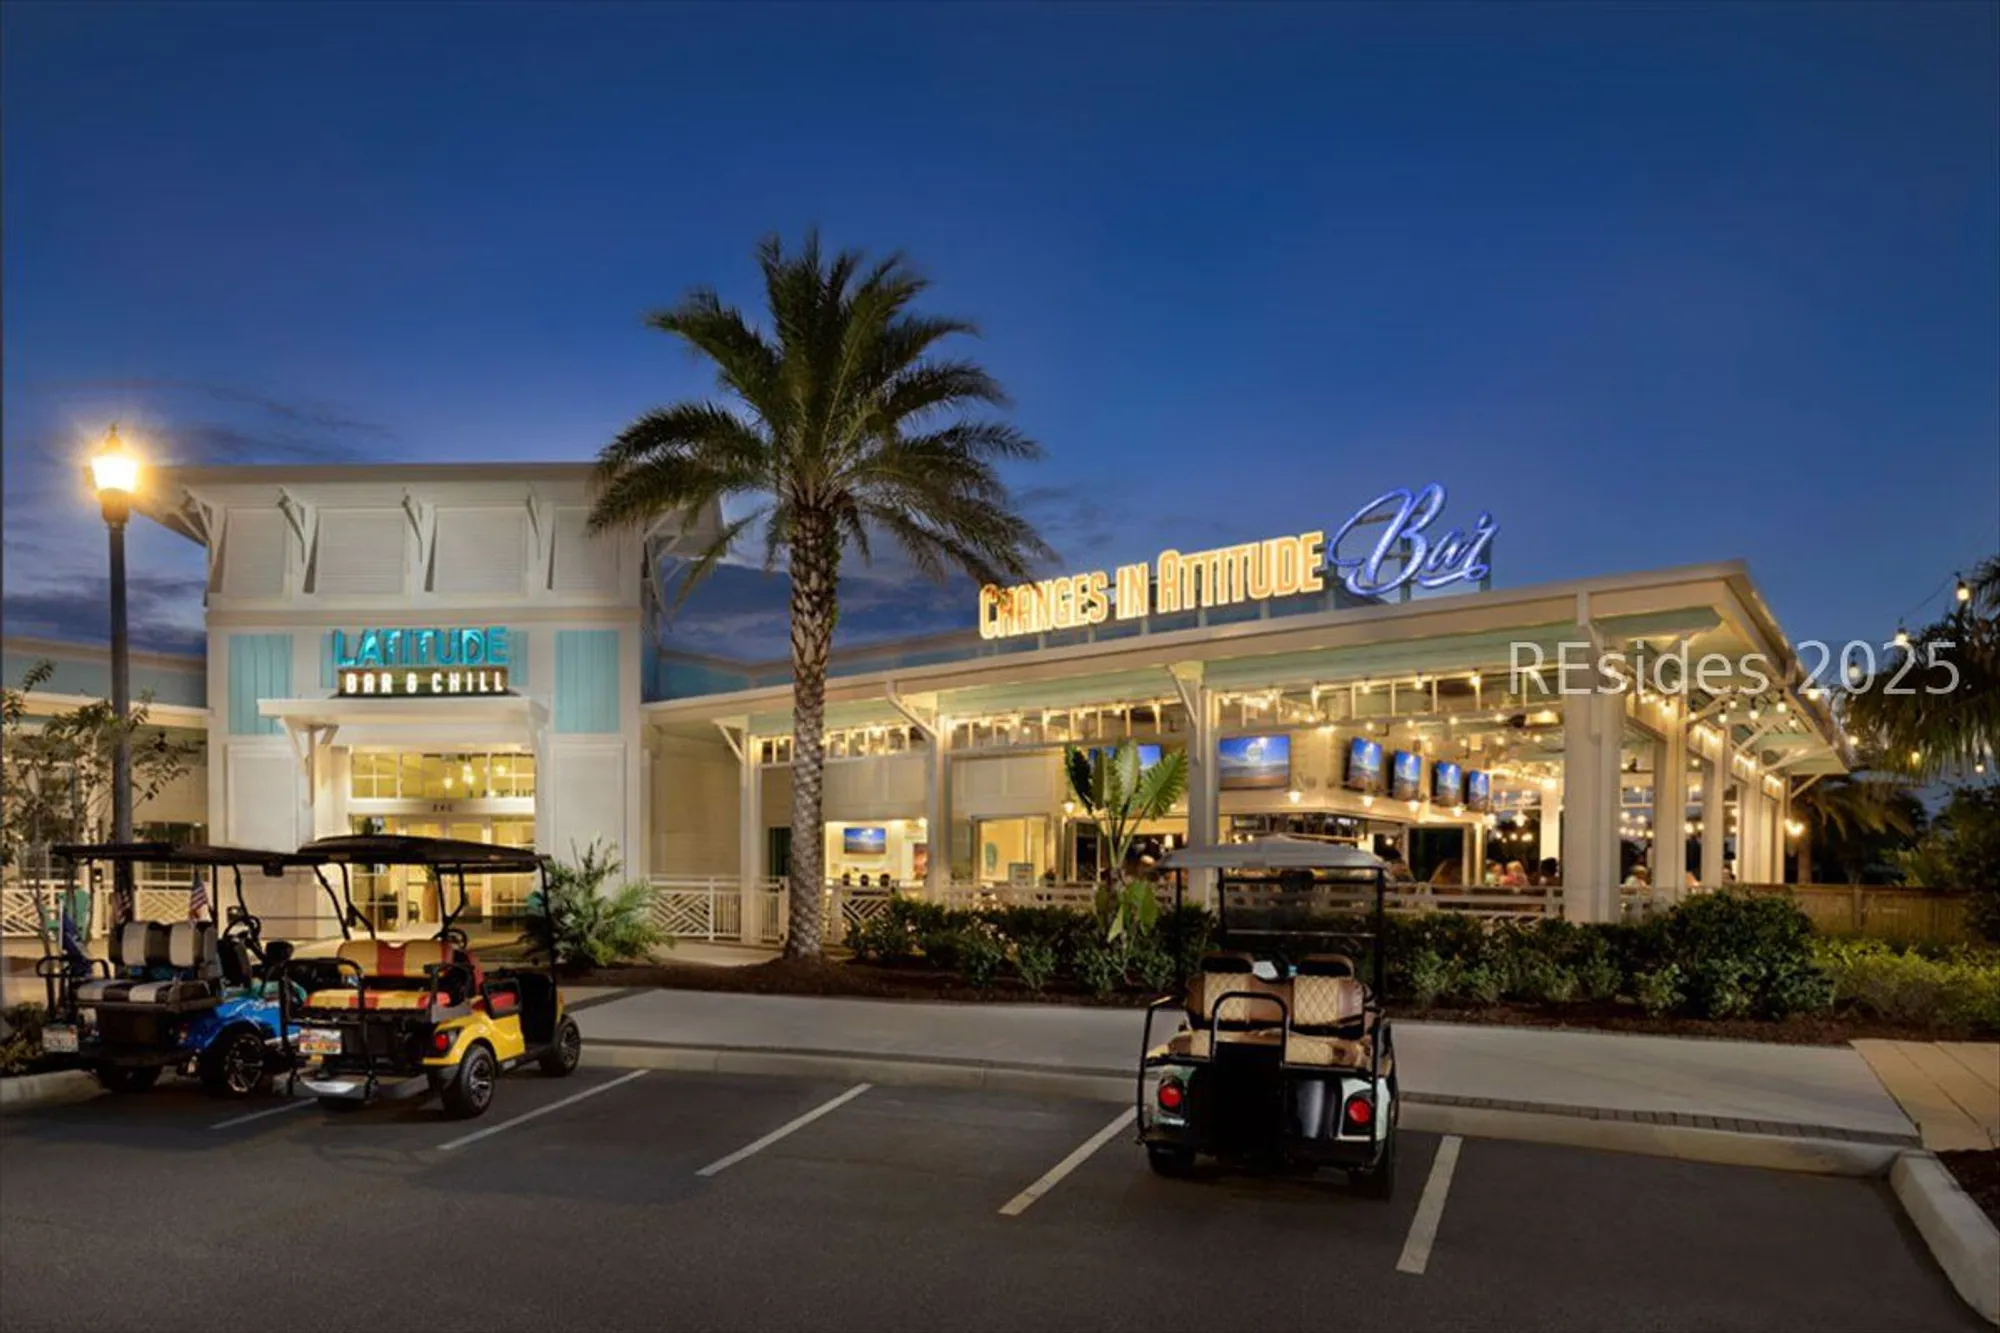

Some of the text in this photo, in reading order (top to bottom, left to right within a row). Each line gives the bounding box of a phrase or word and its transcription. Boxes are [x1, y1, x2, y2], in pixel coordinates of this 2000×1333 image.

[979, 481, 1499, 640] CHANGES IN ATTITUDE Bar
[333, 625, 510, 667] LATITUDE
[345, 672, 393, 694] BAR
[431, 671, 504, 693] CHILL
